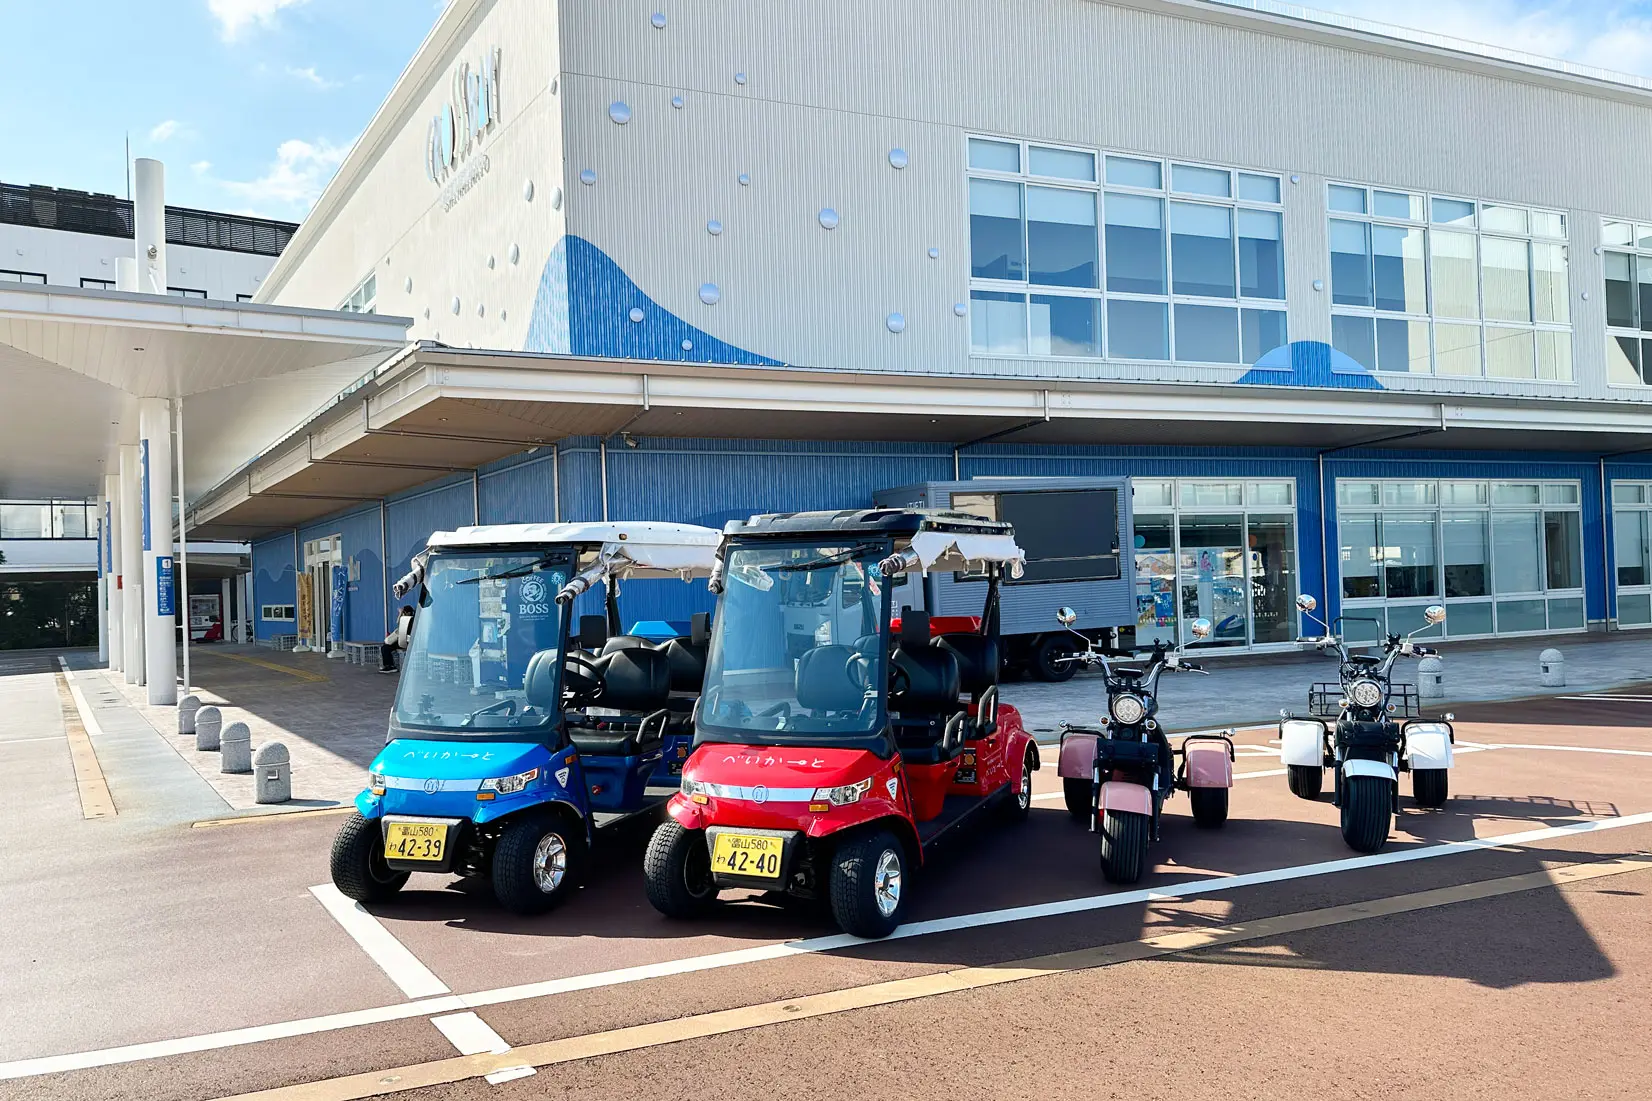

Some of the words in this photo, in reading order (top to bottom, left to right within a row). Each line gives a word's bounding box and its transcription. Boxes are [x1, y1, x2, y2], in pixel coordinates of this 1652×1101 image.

[521, 574, 545, 584] COFFEE
[519, 603, 549, 615] BOSS
[389, 842, 397, 851] わ
[398, 838, 442, 857] 42-39
[716, 854, 726, 864] わ
[727, 850, 778, 874] 42-40
